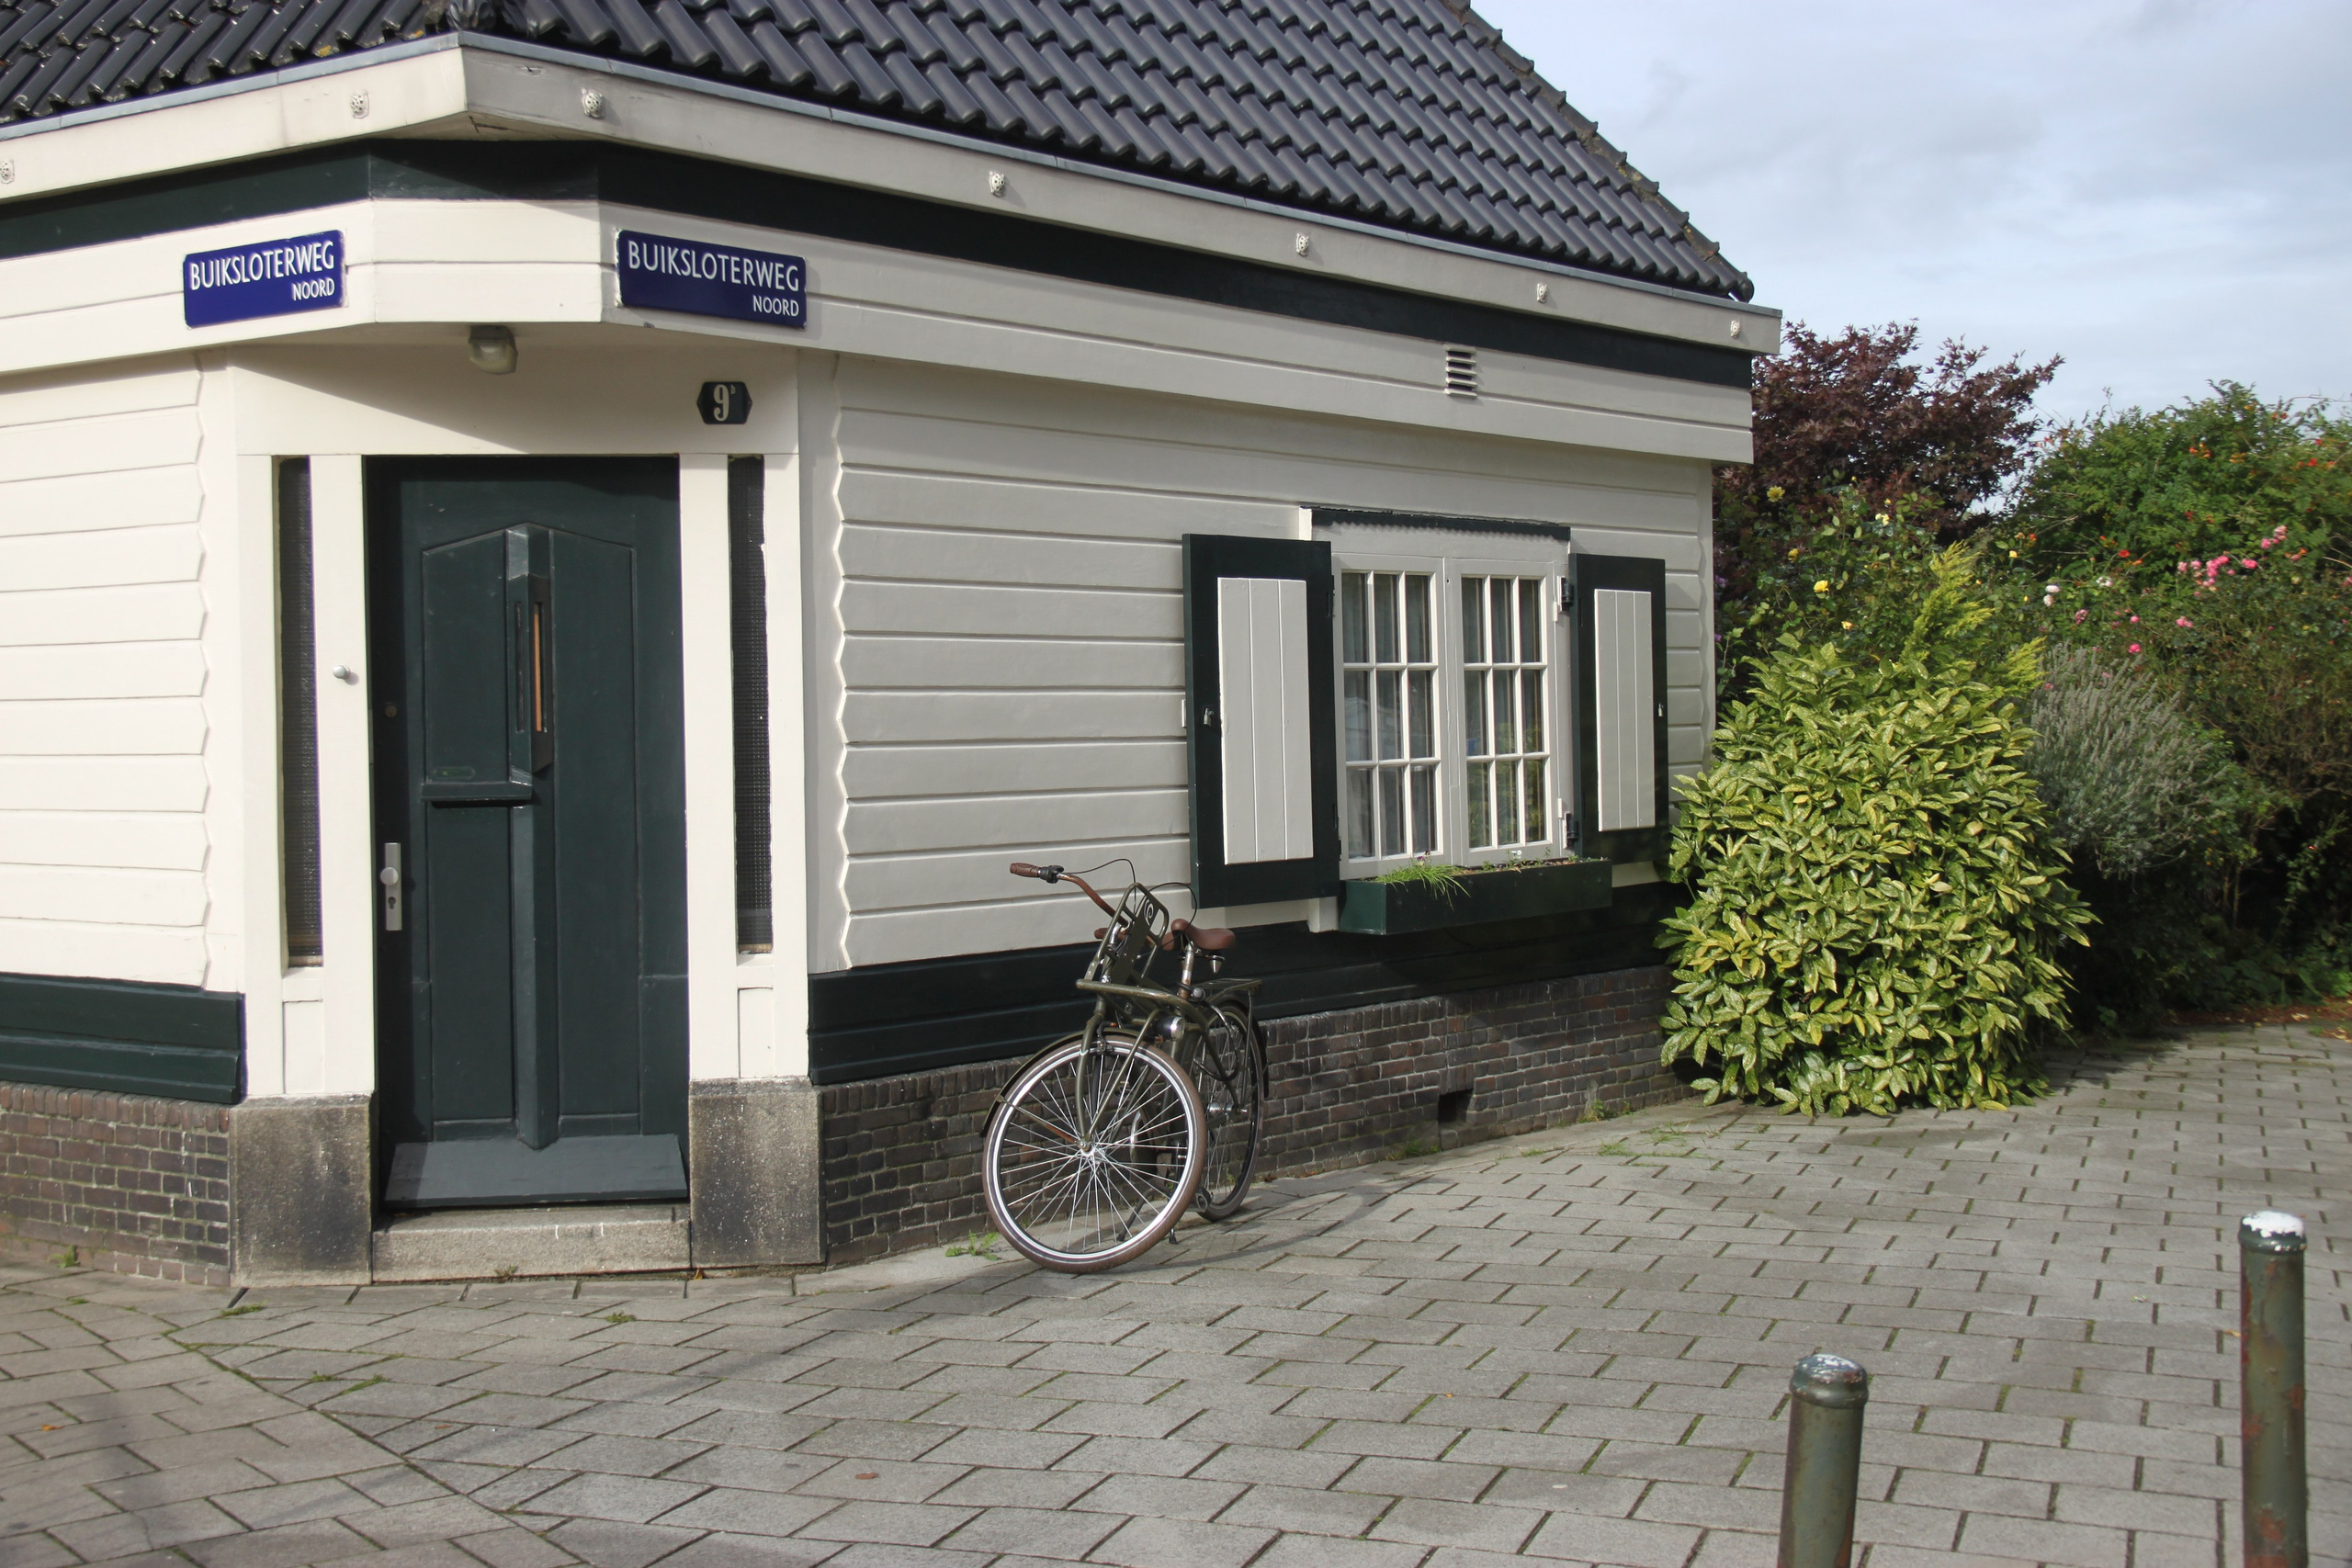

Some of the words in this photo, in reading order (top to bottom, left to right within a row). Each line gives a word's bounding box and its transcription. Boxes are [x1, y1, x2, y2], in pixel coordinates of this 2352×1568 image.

[189, 241, 334, 290] BUIKSLOTERWEG
[628, 240, 799, 291] BUIKSLOTERWEG
[291, 277, 335, 301] NOORD
[752, 294, 799, 317] NOORD
